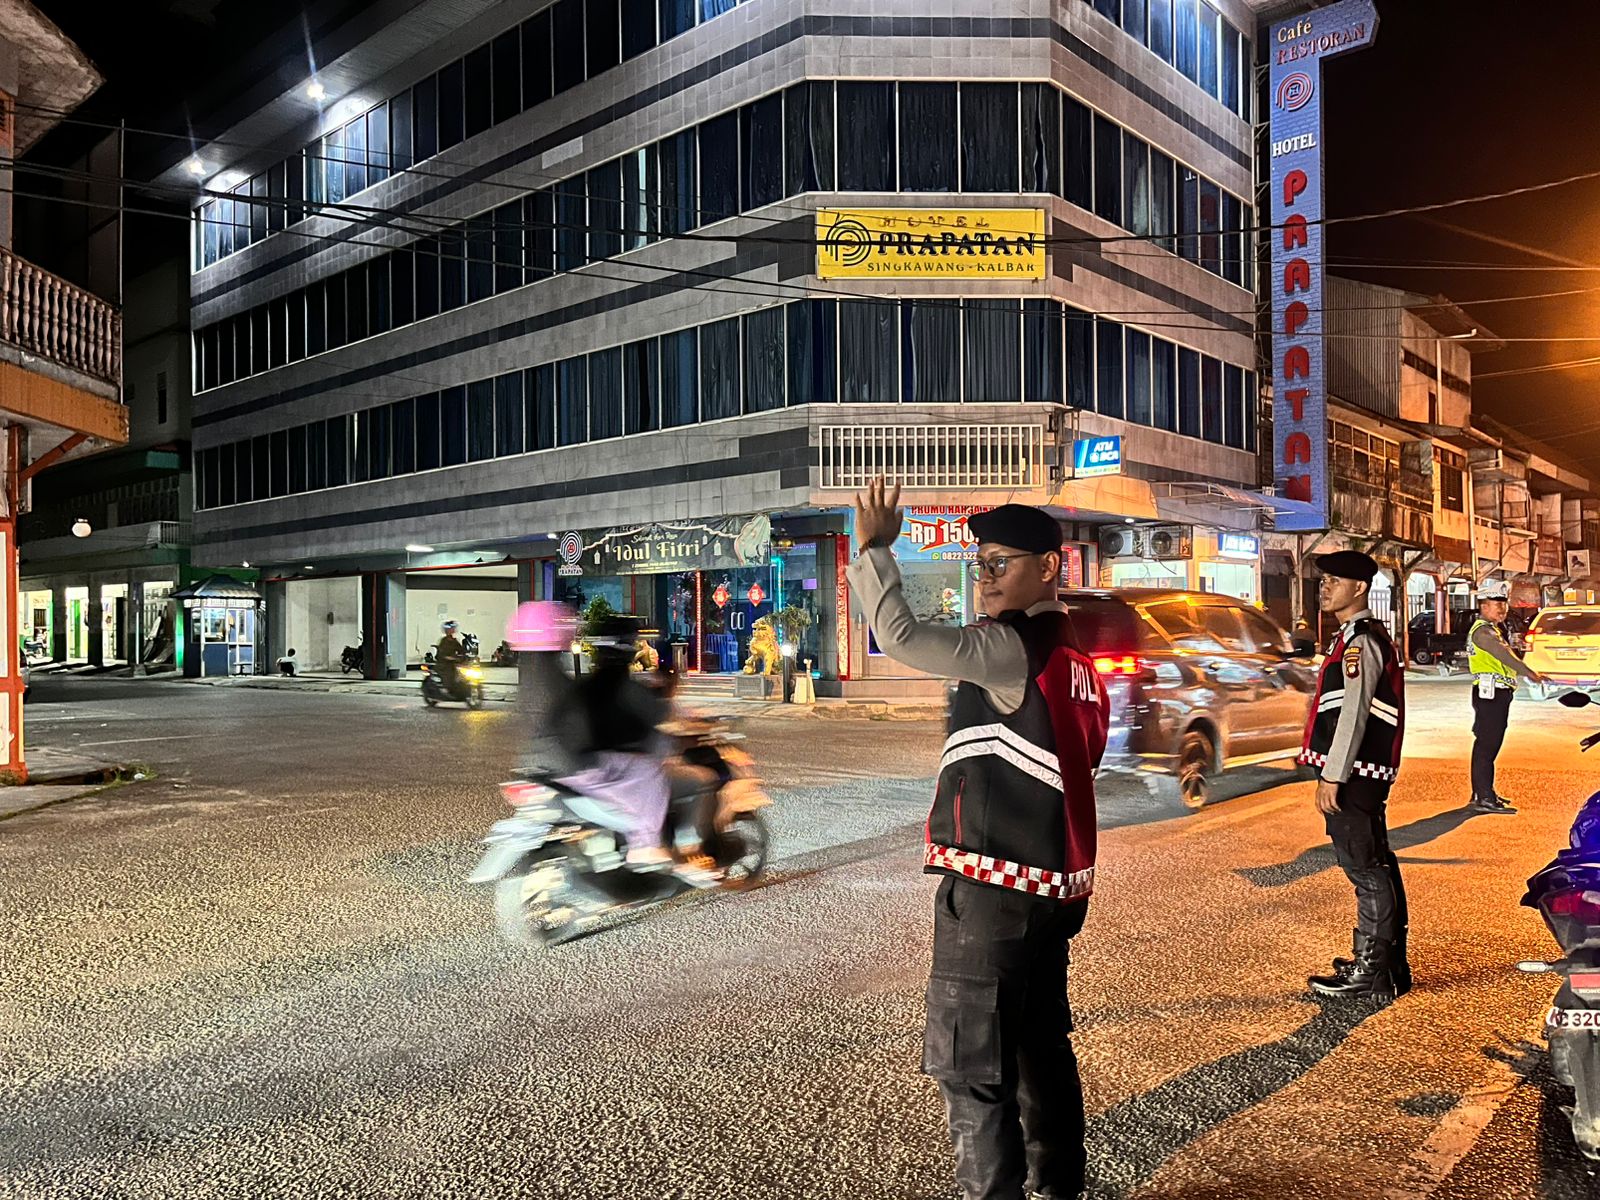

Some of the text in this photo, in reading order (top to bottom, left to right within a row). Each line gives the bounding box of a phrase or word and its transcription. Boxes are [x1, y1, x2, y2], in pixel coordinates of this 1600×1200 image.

[1277, 17, 1312, 43] Café
[1276, 23, 1366, 65] RESTORAN
[1272, 133, 1317, 158] HOTEL
[878, 215, 990, 228] HOTEL
[878, 232, 1037, 256] PRAPATAN
[1283, 169, 1312, 503] PRAPATAN
[1093, 441, 1114, 452] ATM
[911, 505, 946, 515] PROMO
[911, 521, 980, 546] Rp 150.
[613, 540, 700, 562] Idul Fitri
